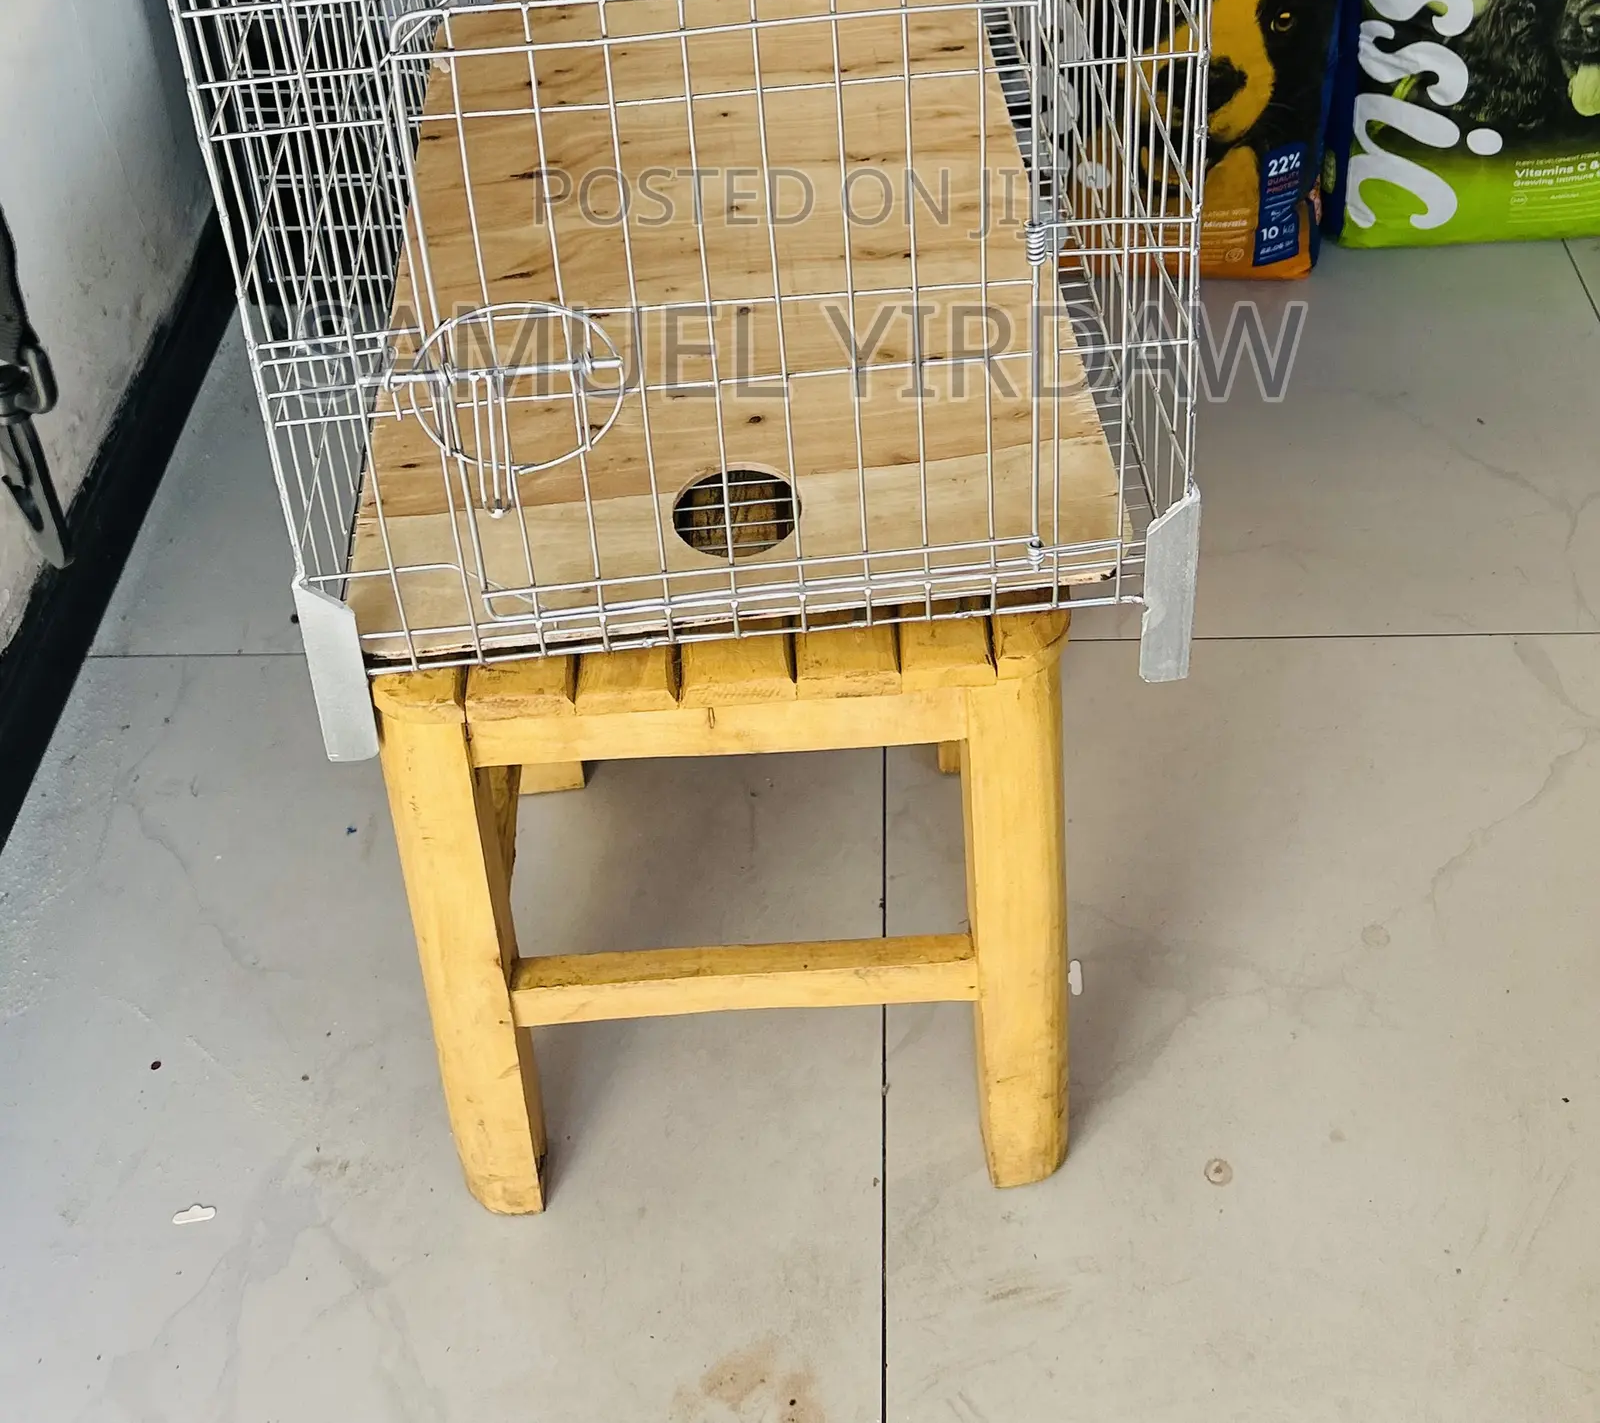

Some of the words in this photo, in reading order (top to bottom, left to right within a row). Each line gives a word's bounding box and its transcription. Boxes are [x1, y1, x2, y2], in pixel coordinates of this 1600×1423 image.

[1268, 151, 1300, 177] 22%
[1515, 165, 1574, 178] Vitamins
[1577, 162, 1587, 172] C
[1513, 178, 1554, 188] Growing
[1556, 172, 1595, 184] Immune
[1261, 226, 1279, 241] 10
